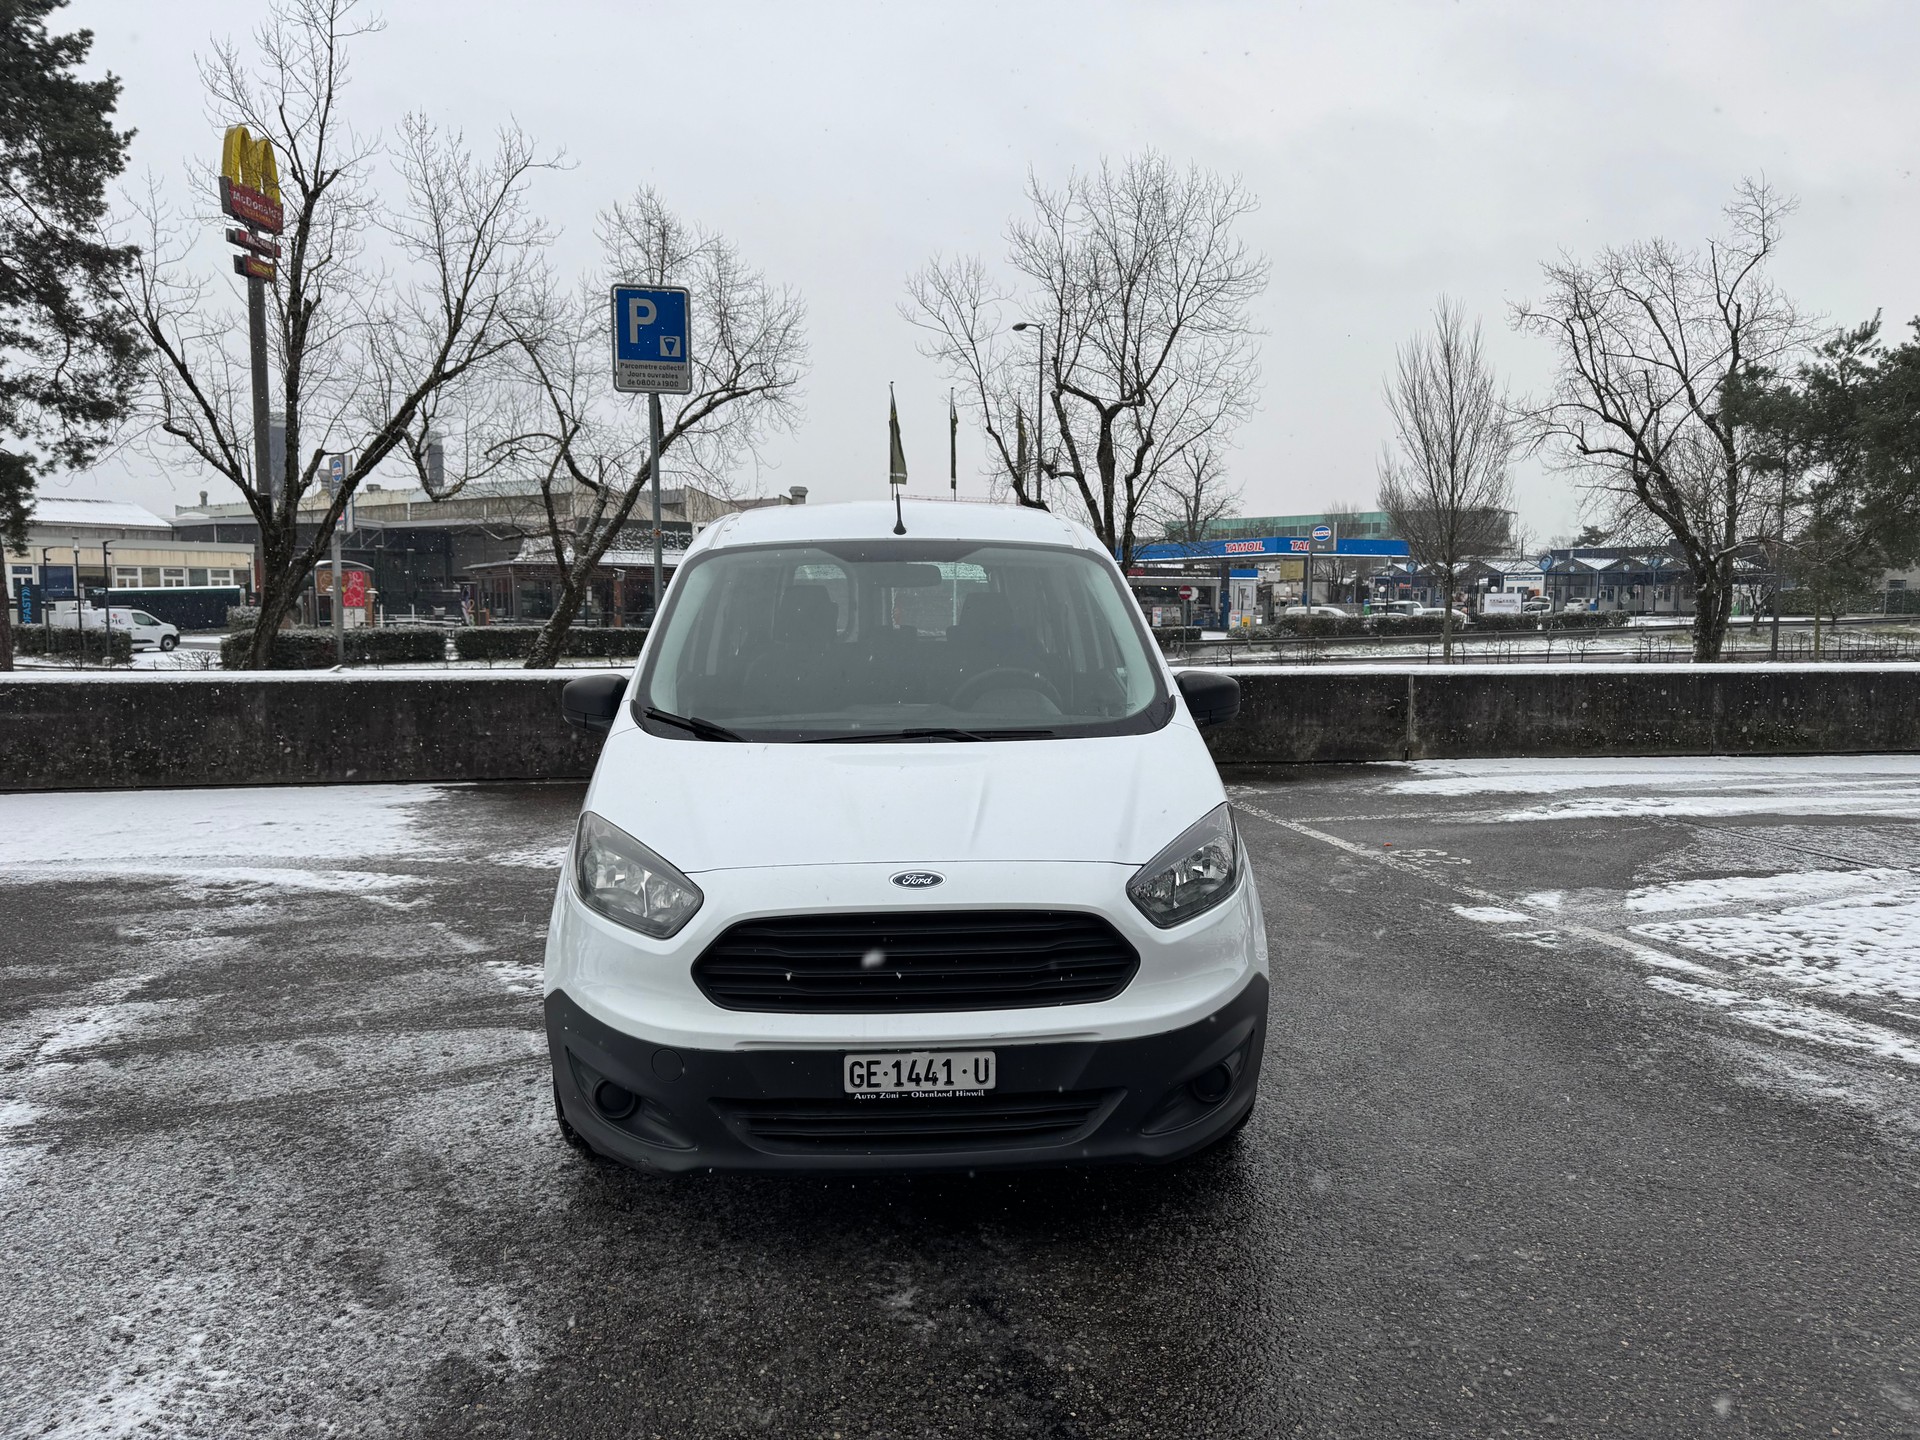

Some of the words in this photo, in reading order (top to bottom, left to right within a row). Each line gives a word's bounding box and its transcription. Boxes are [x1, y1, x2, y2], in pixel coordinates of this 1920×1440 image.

[629, 298, 658, 344] P
[620, 362, 658, 371] Parcomètre
[658, 364, 685, 372] collectif
[646, 372, 679, 380] ouvrables
[1225, 540, 1265, 554] TAMOIL
[902, 873, 934, 886] Ford
[854, 1092, 877, 1100] Auto
[911, 1090, 953, 1099] Oberland
[955, 1089, 985, 1098] Hinwil
